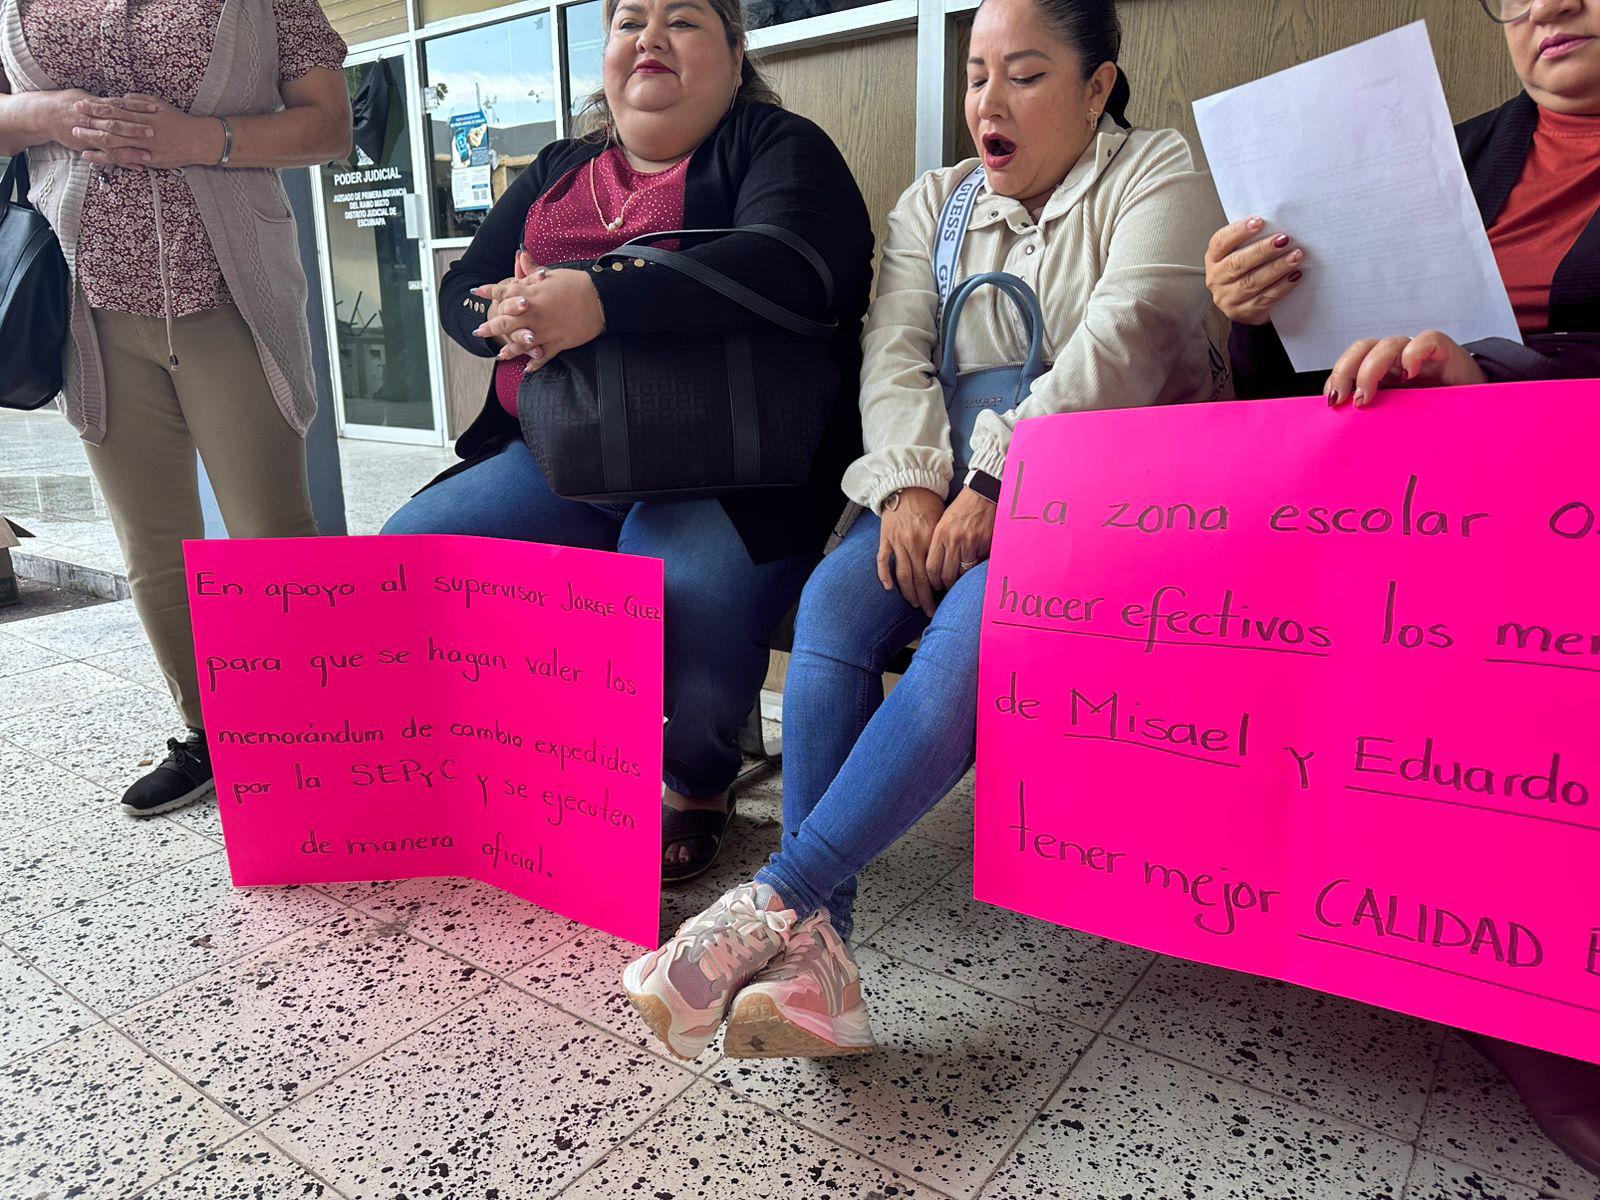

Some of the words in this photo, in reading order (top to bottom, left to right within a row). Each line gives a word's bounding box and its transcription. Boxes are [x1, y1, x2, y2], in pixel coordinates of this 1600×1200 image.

[334, 171, 362, 186] PODER
[363, 167, 401, 182] JUDICIAL
[943, 182, 973, 242] GUESS
[1009, 460, 1068, 525] La
[1101, 502, 1229, 534] zona
[1269, 474, 1490, 537] escolar
[196, 571, 244, 596] En
[264, 582, 357, 614] apoyo
[380, 562, 407, 593] al
[433, 576, 550, 609] supervisor
[560, 581, 616, 617] JORGE
[999, 575, 1105, 622] hacer
[1121, 586, 1332, 654] efectivos
[1381, 580, 1455, 649] los
[206, 656, 282, 693] para
[310, 654, 365, 688] que
[378, 649, 411, 666] se
[427, 636, 507, 683] hagan
[525, 648, 584, 683] valer
[605, 658, 638, 696] los
[401, 715, 433, 739] de
[450, 719, 523, 748] cambio
[534, 738, 642, 778] expedidos
[994, 671, 1041, 720] de
[1070, 687, 1249, 757] Misael
[1354, 735, 1590, 807] Eduardo
[233, 782, 272, 805] por
[294, 762, 322, 790] la
[504, 779, 528, 799] se
[543, 786, 636, 830] ejecuten
[301, 829, 333, 854] de
[347, 834, 455, 855] manera
[481, 831, 554, 878] oficial.
[1008, 780, 1126, 874] tener
[1143, 861, 1281, 936] mejor
[1315, 878, 1544, 968] CALIDAD
